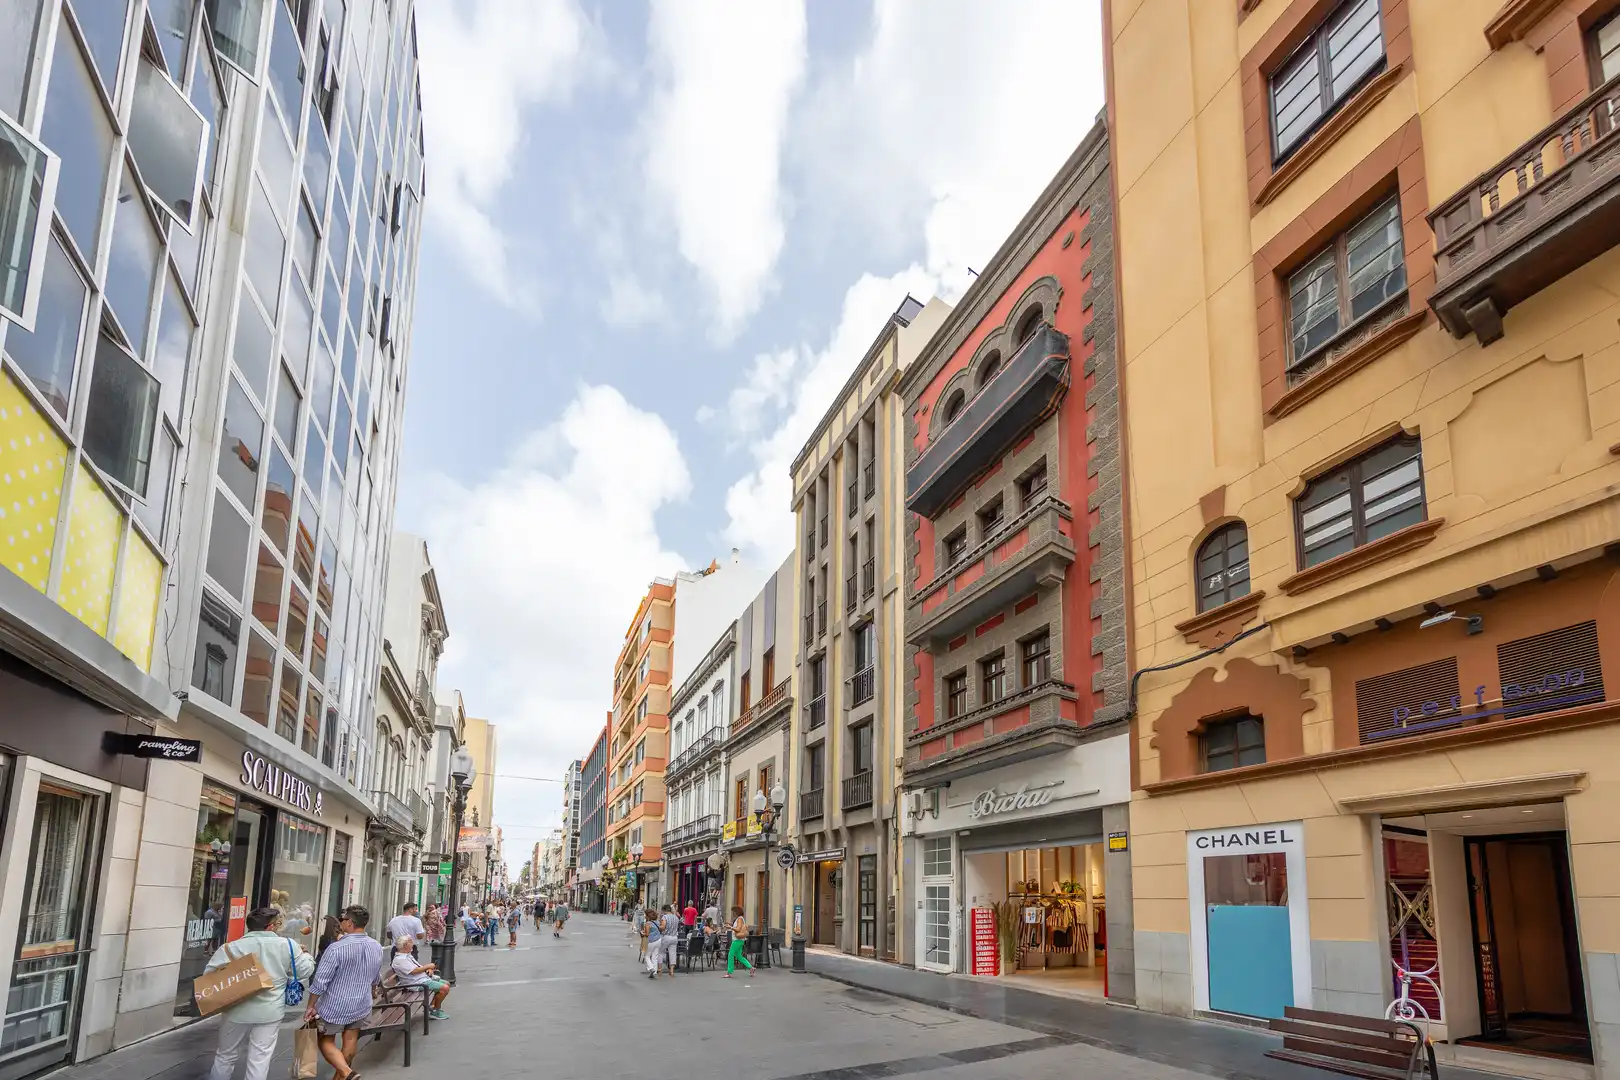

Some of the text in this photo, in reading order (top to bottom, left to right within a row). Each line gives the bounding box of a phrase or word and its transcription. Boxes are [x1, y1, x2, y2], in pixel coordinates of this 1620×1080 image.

[138, 740, 196, 755] pampling
[240, 750, 312, 811] SCALPERS
[1195, 829, 1294, 849] CHANEL
[186, 918, 215, 941] REBAJAS
[194, 966, 258, 1000] SCALPERS
